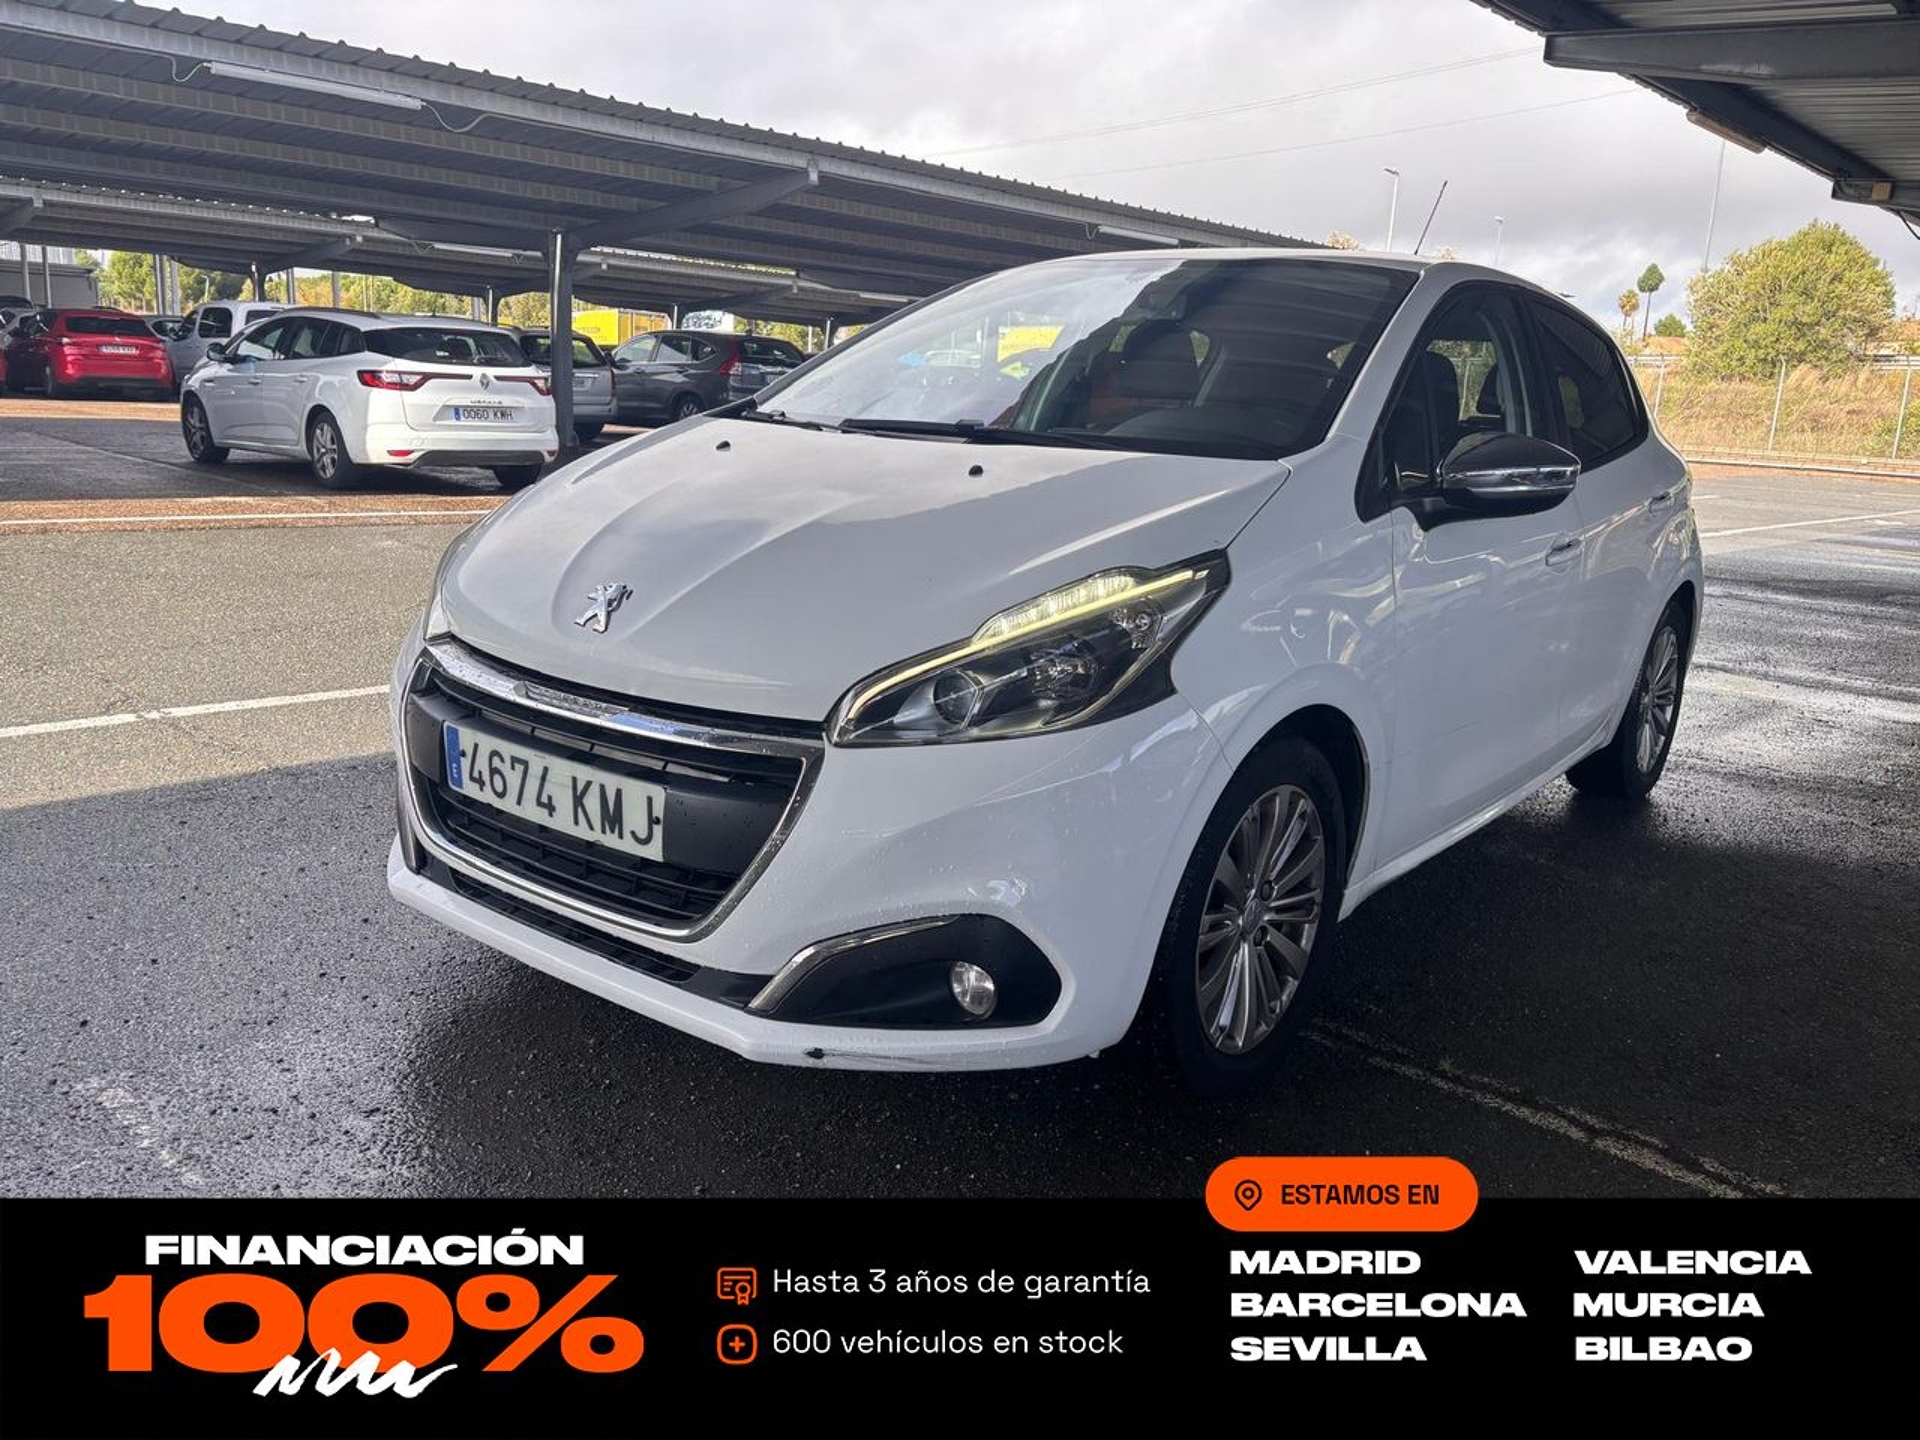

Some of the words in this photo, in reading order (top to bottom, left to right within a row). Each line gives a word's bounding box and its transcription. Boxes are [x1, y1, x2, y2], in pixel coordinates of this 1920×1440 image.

[462, 408, 490, 420] 0060
[469, 742, 556, 818] 4674
[571, 775, 655, 847] KMJ
